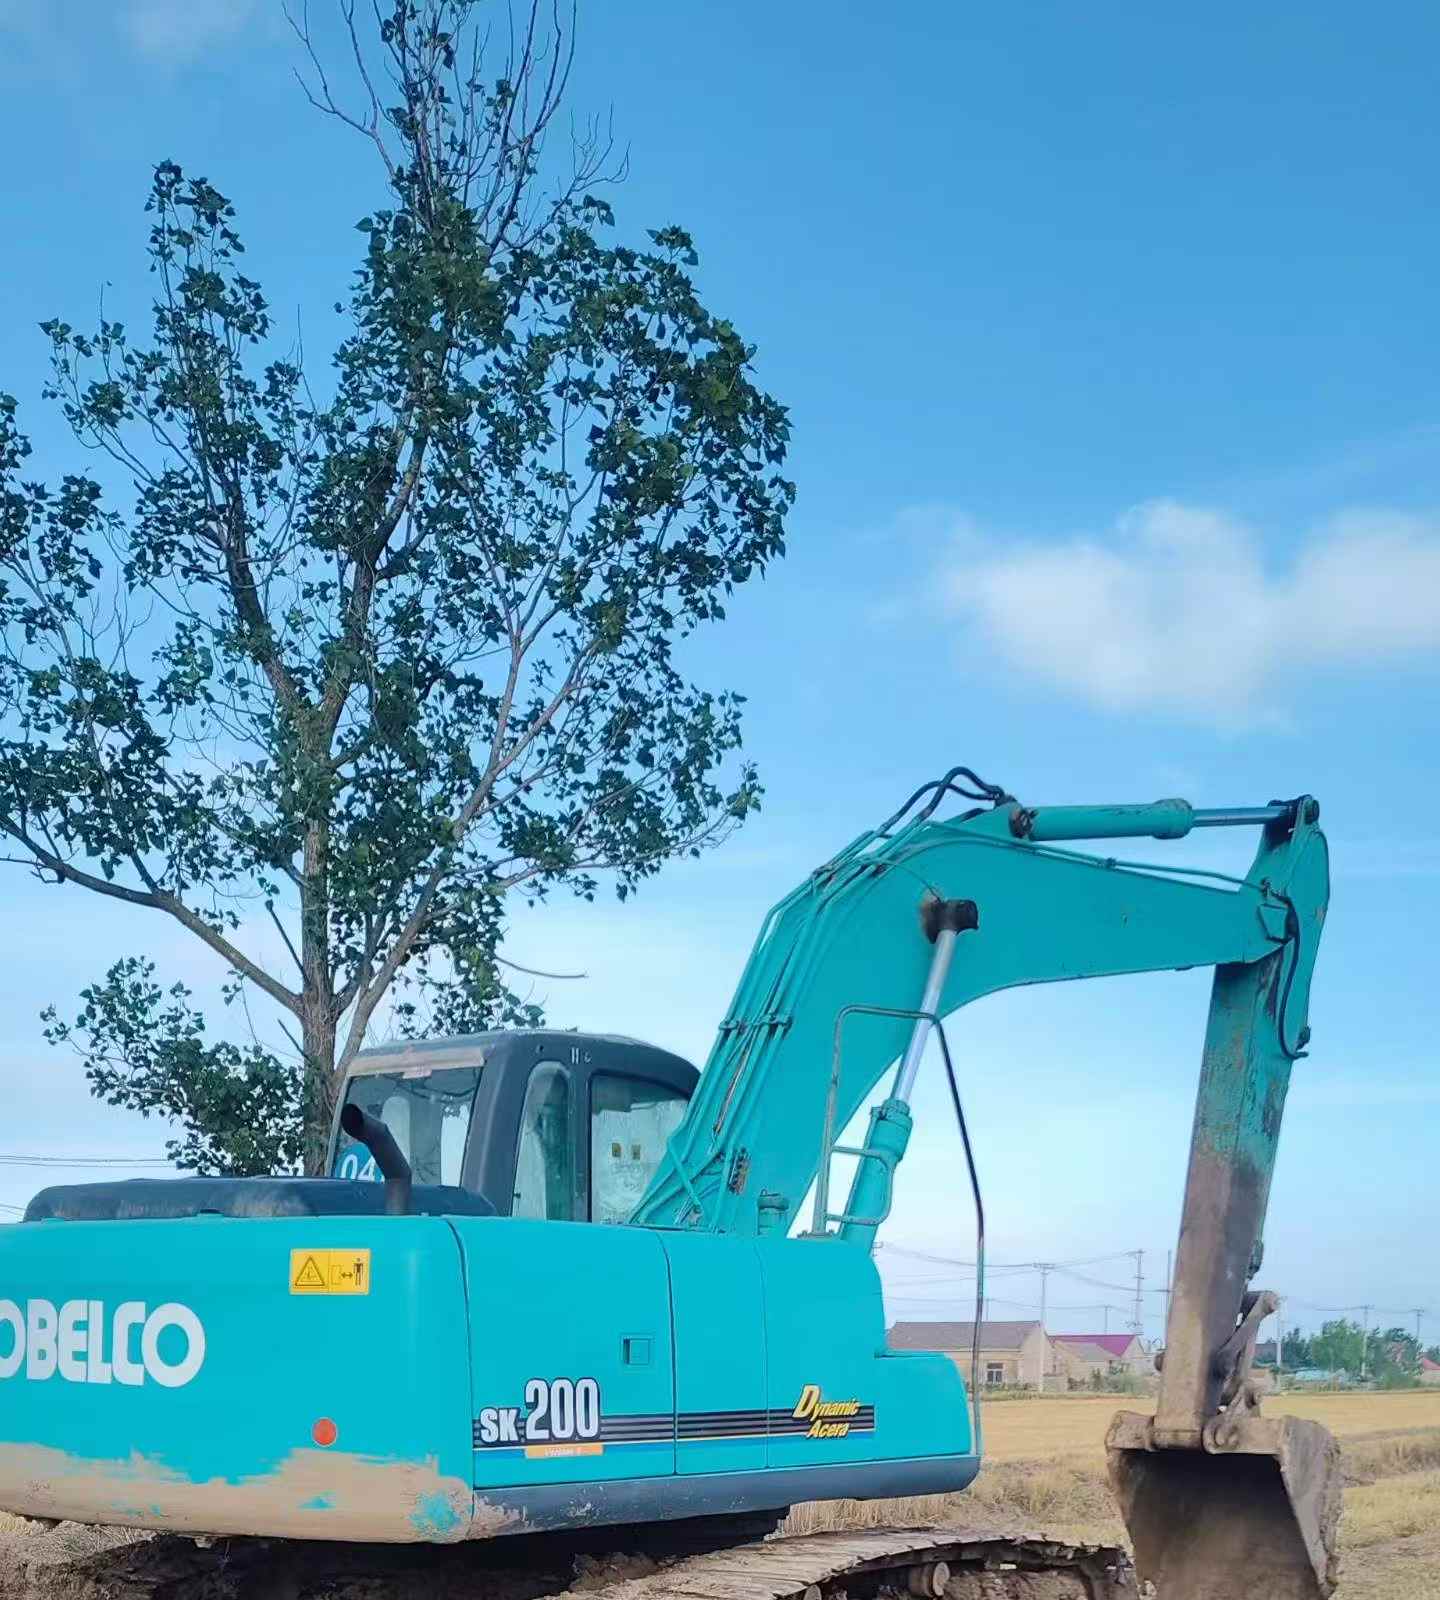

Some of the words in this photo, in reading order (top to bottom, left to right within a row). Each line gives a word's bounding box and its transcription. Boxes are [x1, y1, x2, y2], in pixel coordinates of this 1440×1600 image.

[340, 1153, 385, 1183] 04
[525, 1378, 599, 1440] 200
[792, 1384, 859, 1422] Dynamic
[805, 1419, 850, 1439] Acera
